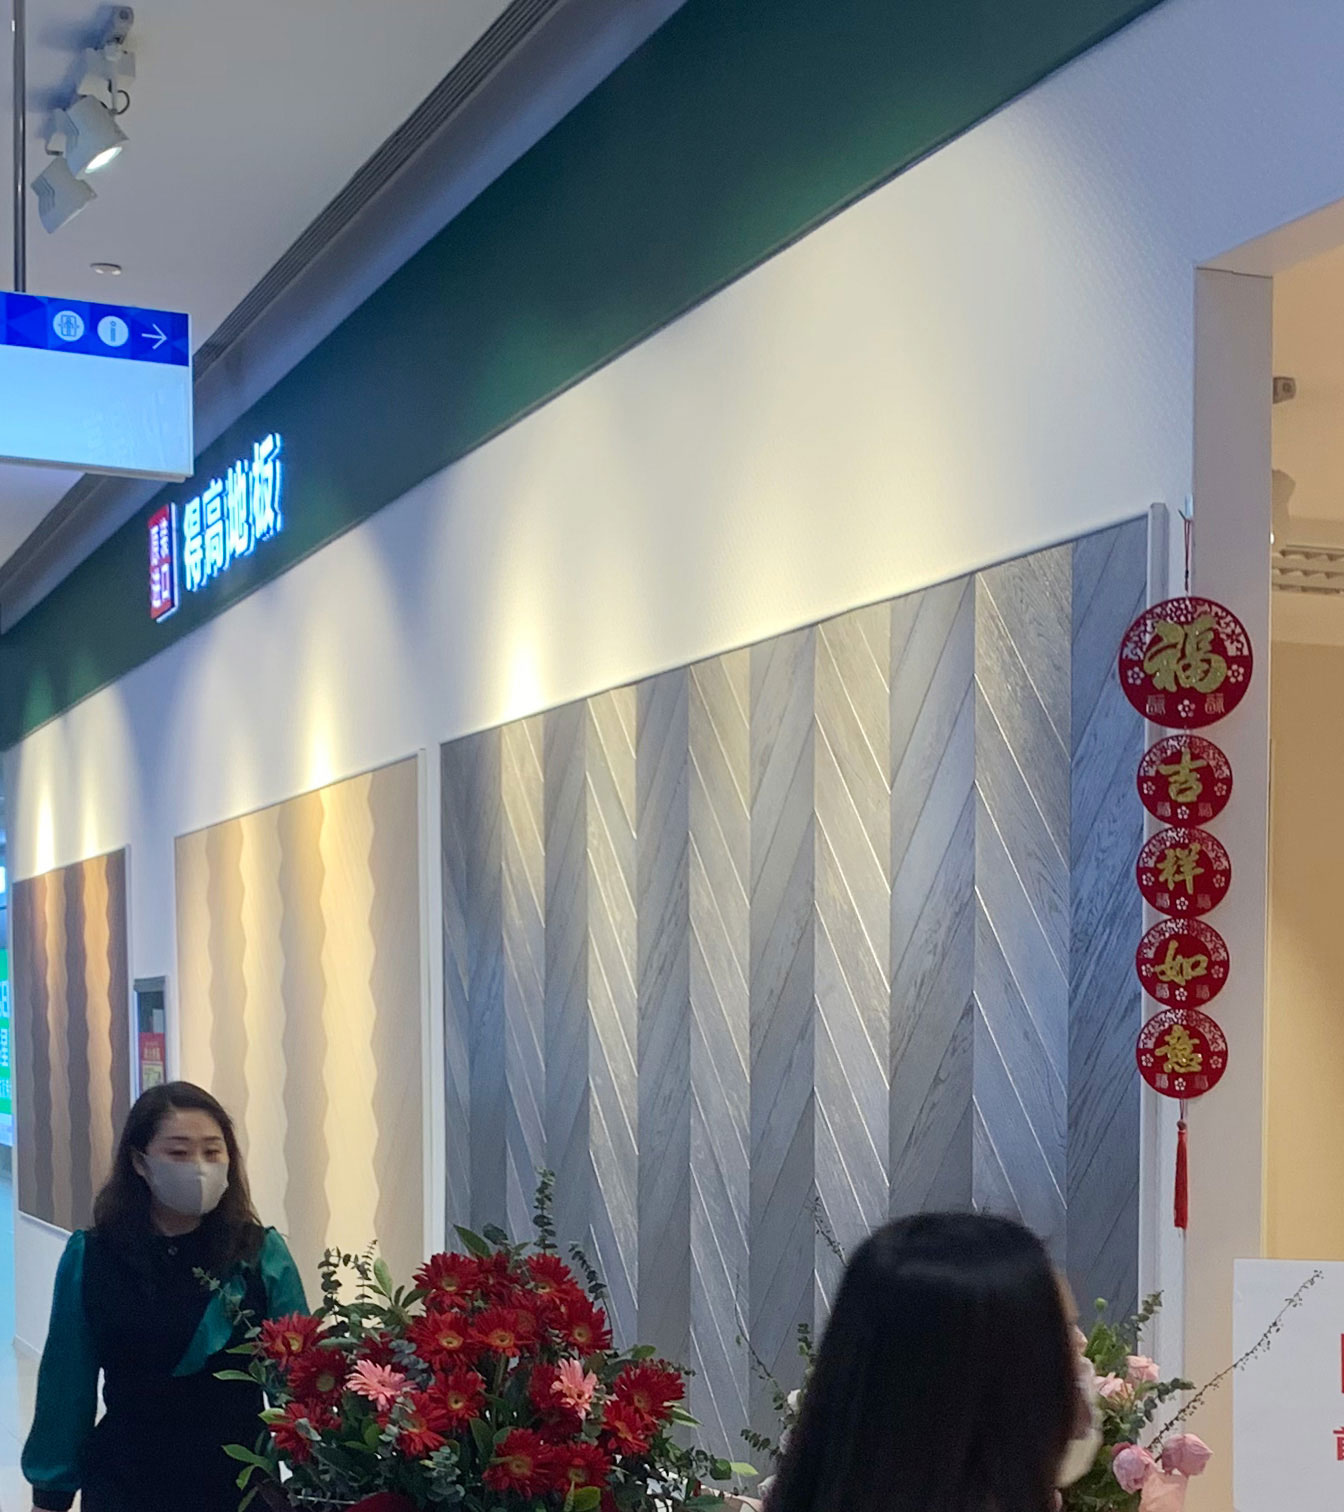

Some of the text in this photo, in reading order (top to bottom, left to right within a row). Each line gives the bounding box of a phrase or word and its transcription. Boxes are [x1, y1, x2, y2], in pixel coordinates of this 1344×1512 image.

[182, 432, 283, 593] 得高地板
[1142, 615, 1227, 695] 福
